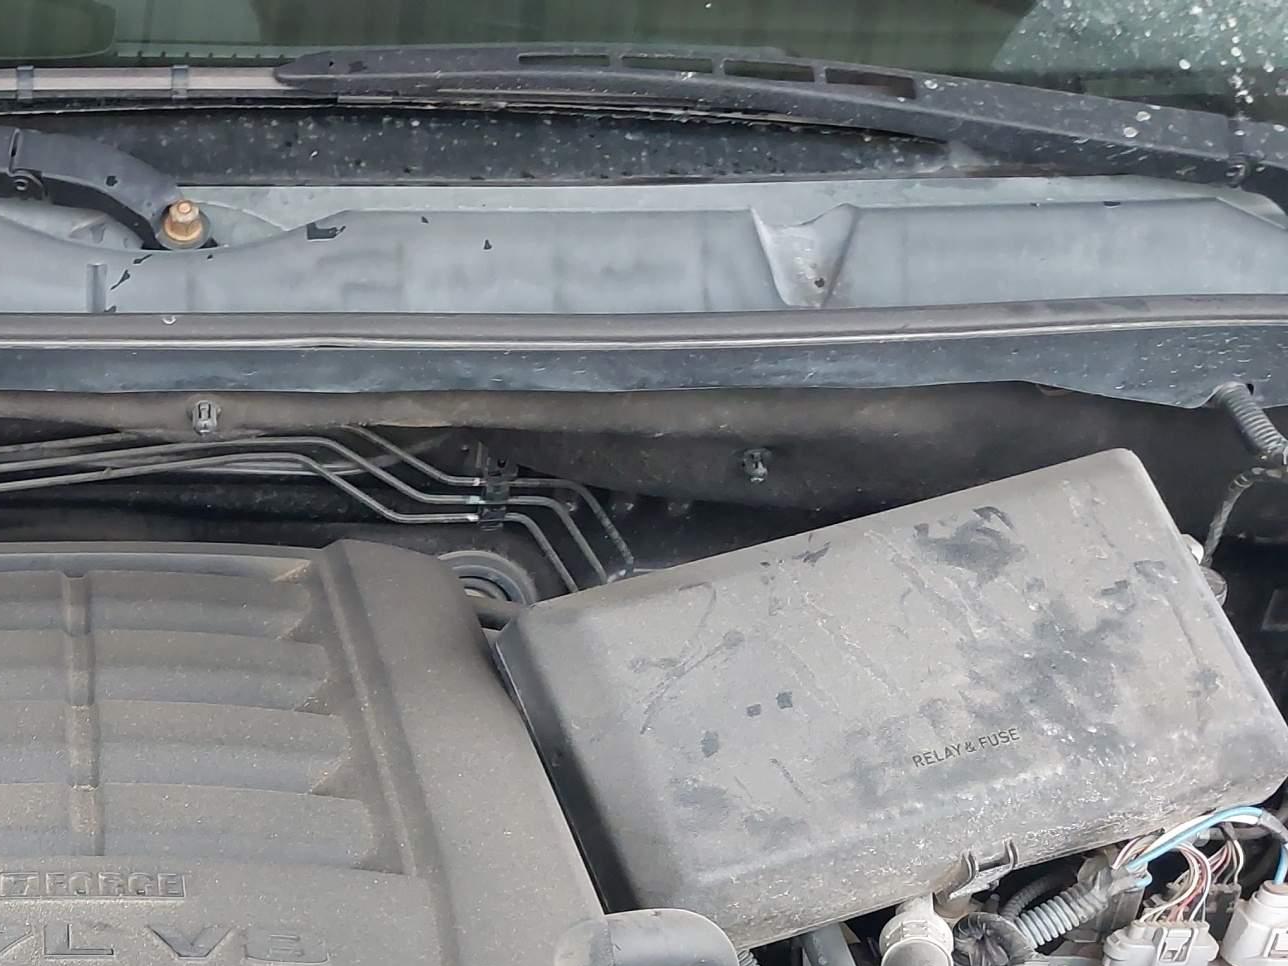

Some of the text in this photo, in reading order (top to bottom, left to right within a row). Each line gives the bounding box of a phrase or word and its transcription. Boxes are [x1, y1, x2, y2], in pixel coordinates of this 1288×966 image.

[912, 727, 1021, 768] RELAY & FUSE
